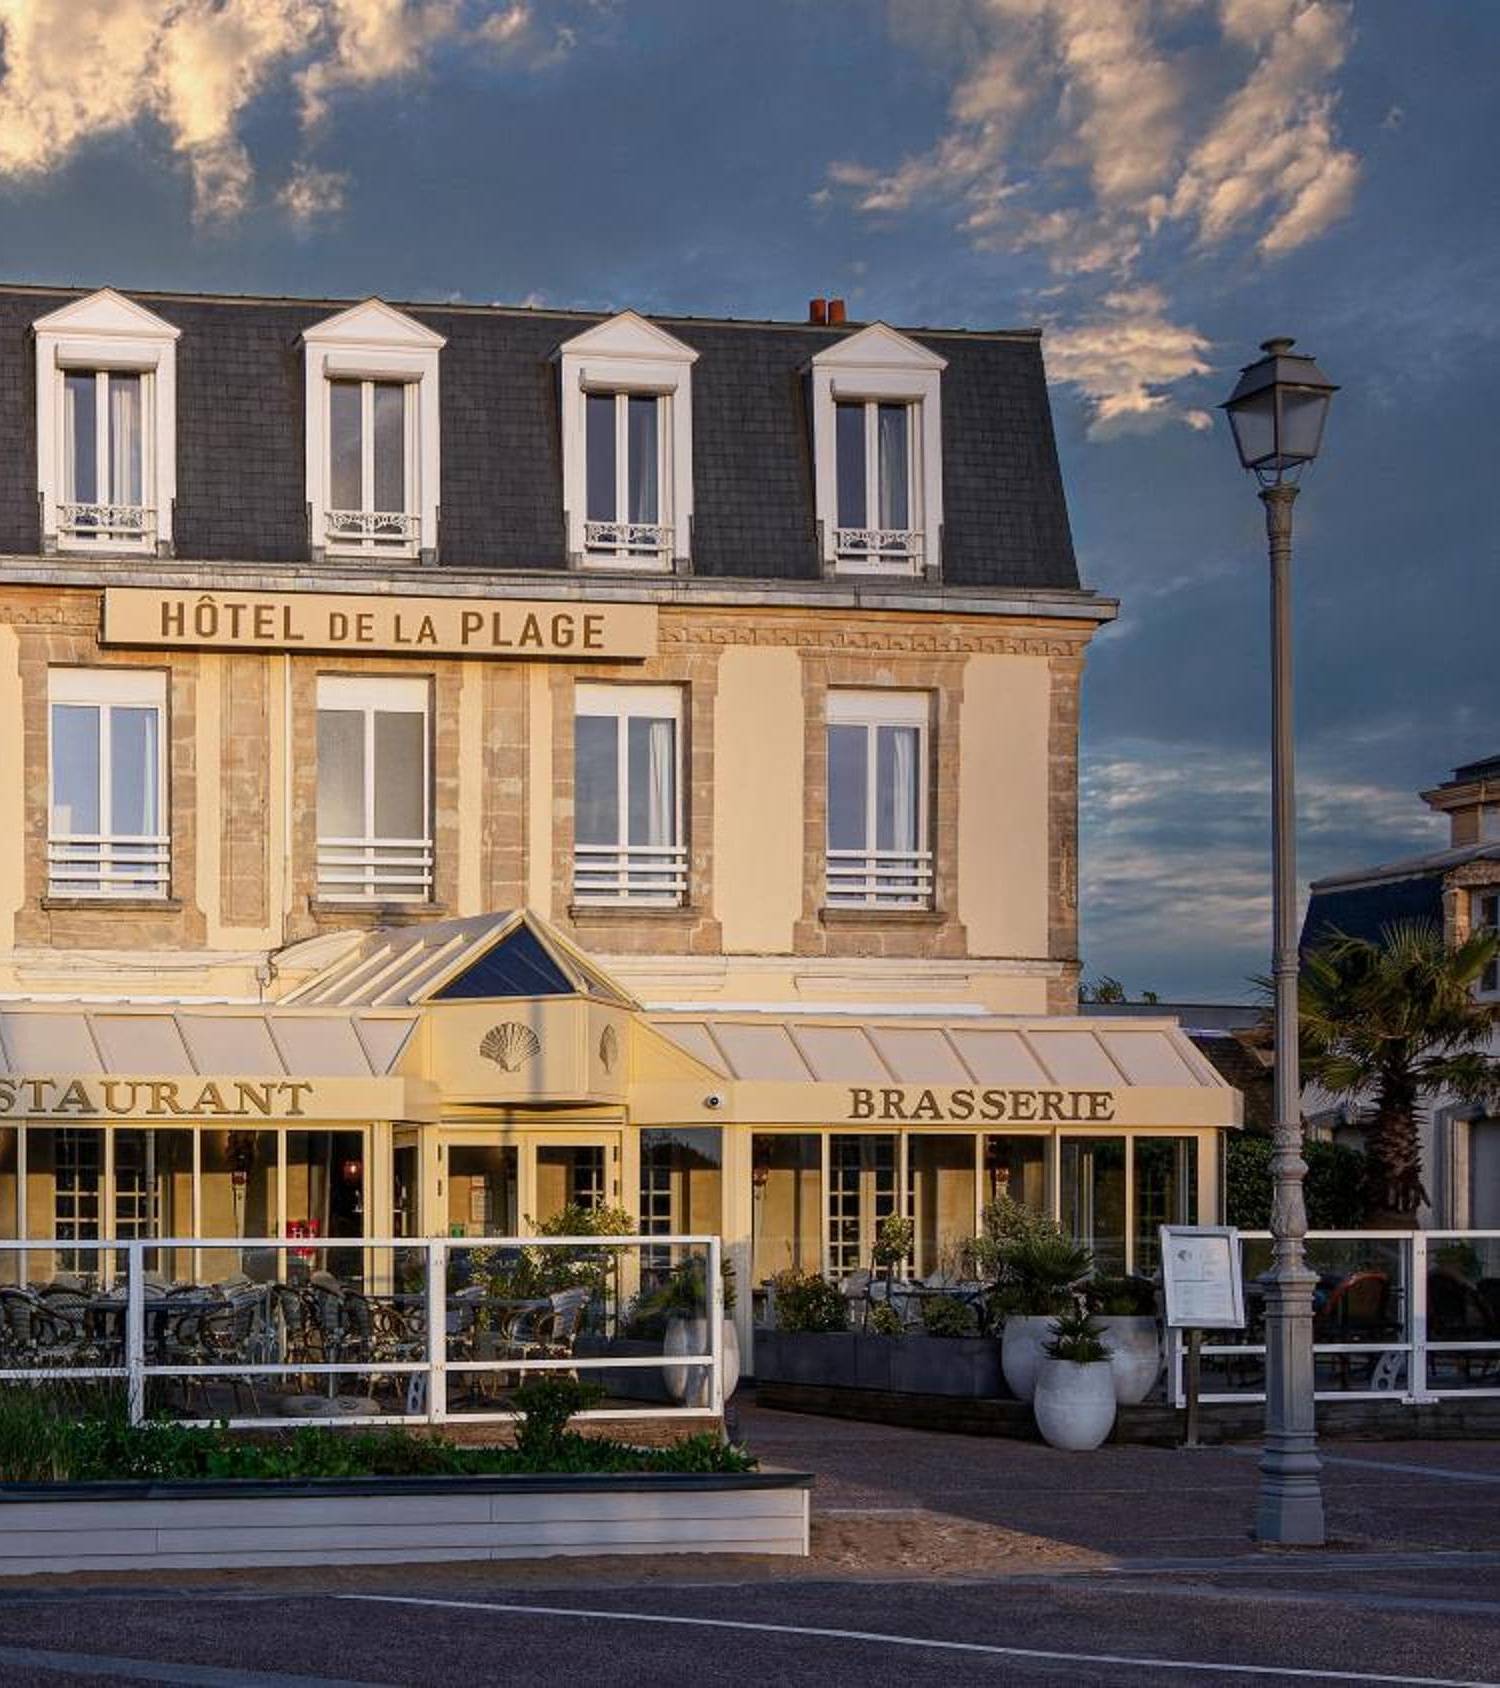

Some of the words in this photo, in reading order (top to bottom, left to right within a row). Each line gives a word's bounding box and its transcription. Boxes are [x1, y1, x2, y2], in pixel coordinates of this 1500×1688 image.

[160, 594, 304, 640] HÔTEL
[329, 612, 374, 642] DE
[394, 614, 438, 644] LA
[461, 611, 604, 648] PLAGE
[848, 1088, 1115, 1121] BRASSERIE
